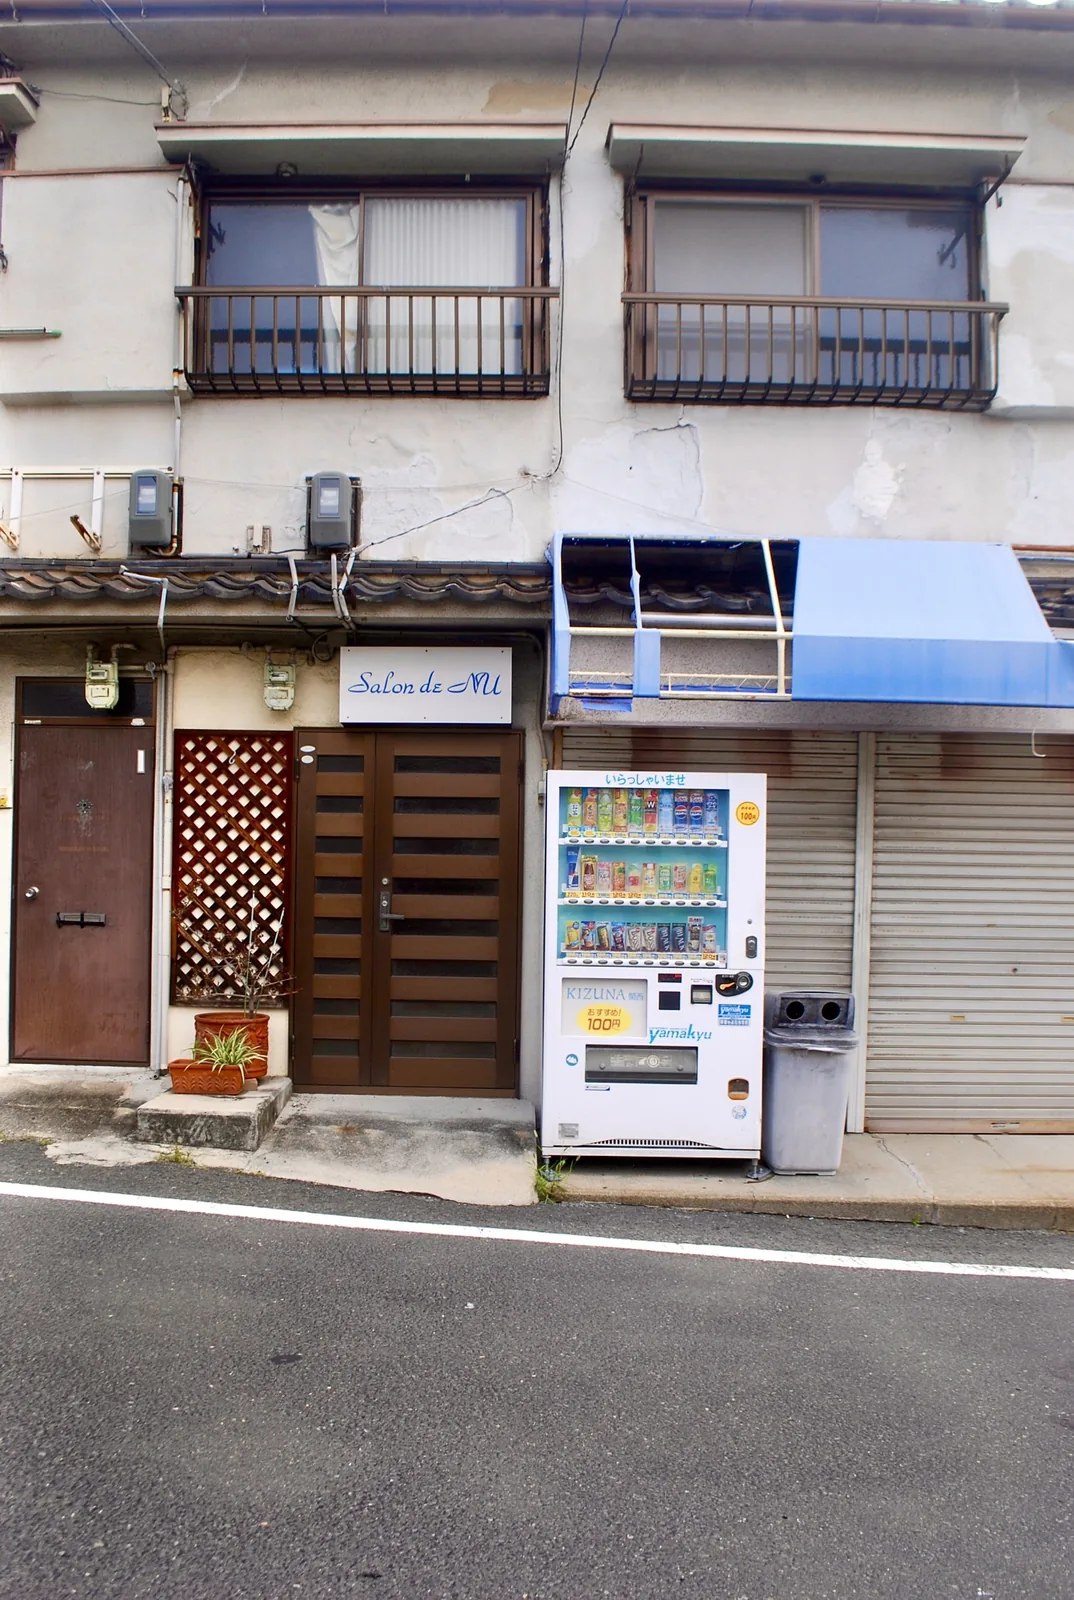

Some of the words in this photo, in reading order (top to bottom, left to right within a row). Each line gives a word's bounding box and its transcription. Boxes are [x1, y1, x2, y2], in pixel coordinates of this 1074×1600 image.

[348, 671, 415, 694] Salon
[419, 670, 442, 694] de
[605, 774, 686, 786] いらっしゃいませ
[566, 987, 625, 1000] KIZUNA
[587, 1008, 622, 1016] おすすめ!
[587, 1018, 621, 1031] 100円
[649, 1024, 712, 1044] yamakyu
